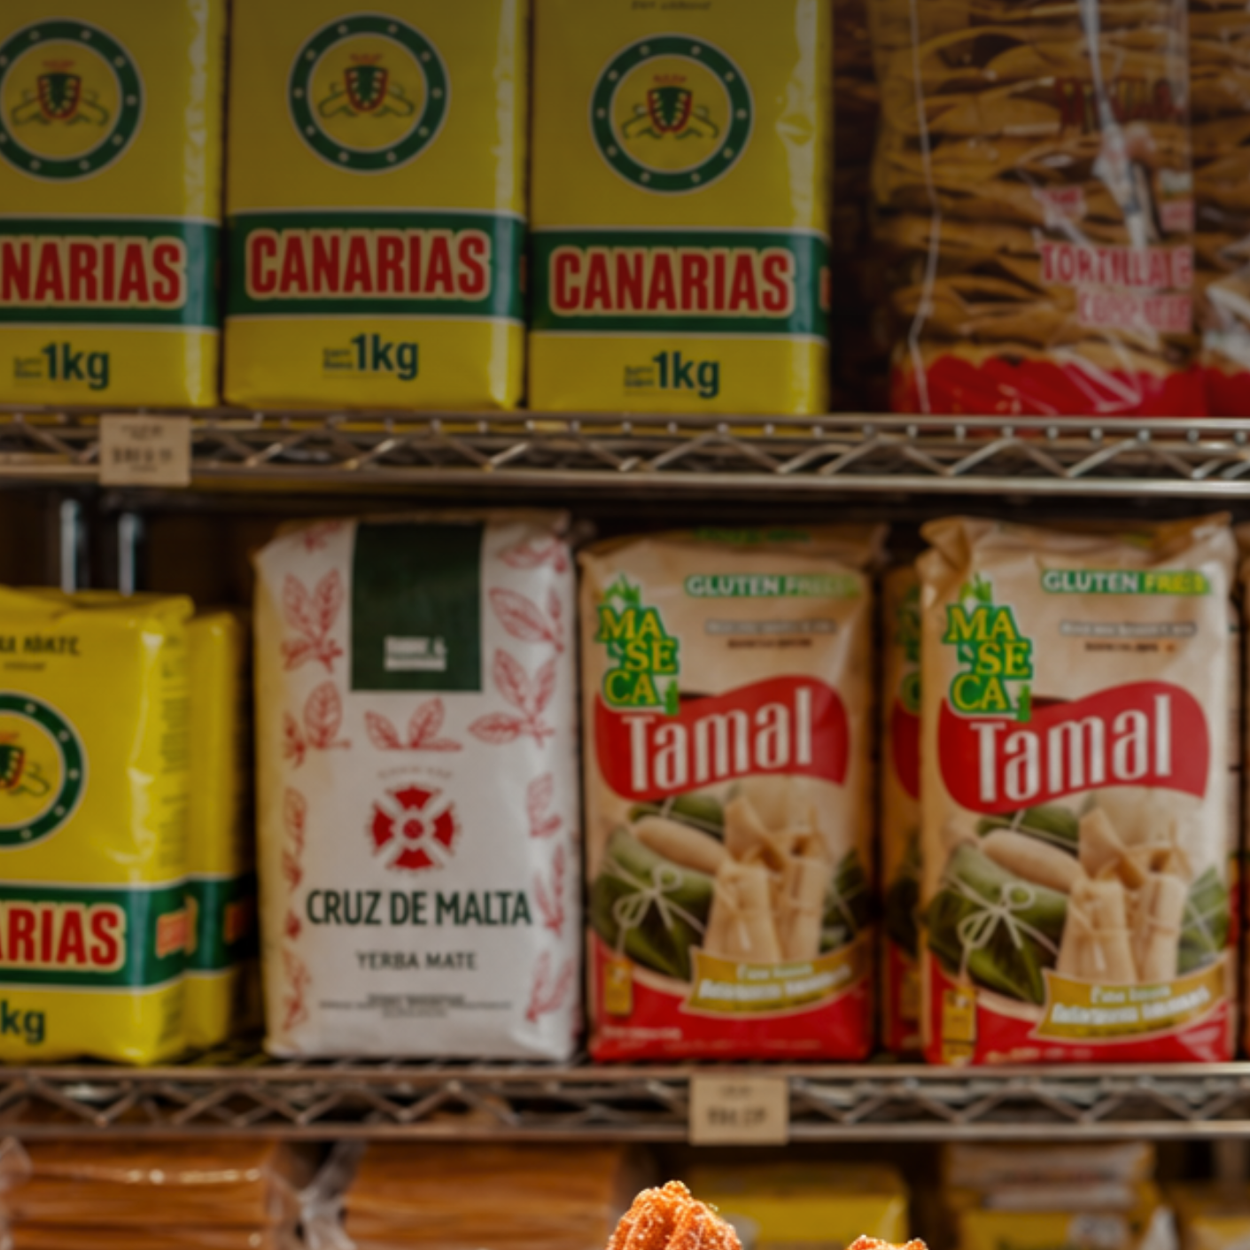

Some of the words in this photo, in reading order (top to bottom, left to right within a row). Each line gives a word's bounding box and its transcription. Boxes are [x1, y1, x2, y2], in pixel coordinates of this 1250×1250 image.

[249, 232, 488, 298] CANARIAS
[551, 249, 793, 315] CANARIAS
[42, 343, 109, 390] 1kg
[350, 334, 420, 380] 1kg
[653, 351, 721, 399] 1kg
[686, 574, 780, 596] GLUTEN
[1042, 570, 1138, 593] GLUTEN
[600, 607, 662, 641] MA
[947, 606, 1016, 642] MA
[625, 638, 676, 673] SE
[975, 640, 1030, 677] SE
[604, 670, 657, 706] CA
[951, 675, 1009, 711] CA
[620, 686, 812, 793] Tamal
[968, 694, 1173, 803] Tamal
[306, 890, 382, 925] CRUZ
[390, 890, 427, 925] DE
[435, 890, 533, 925] MALTA
[0, 904, 124, 968] RIAS
[355, 951, 419, 971] YERBA
[425, 951, 478, 970] MATE
